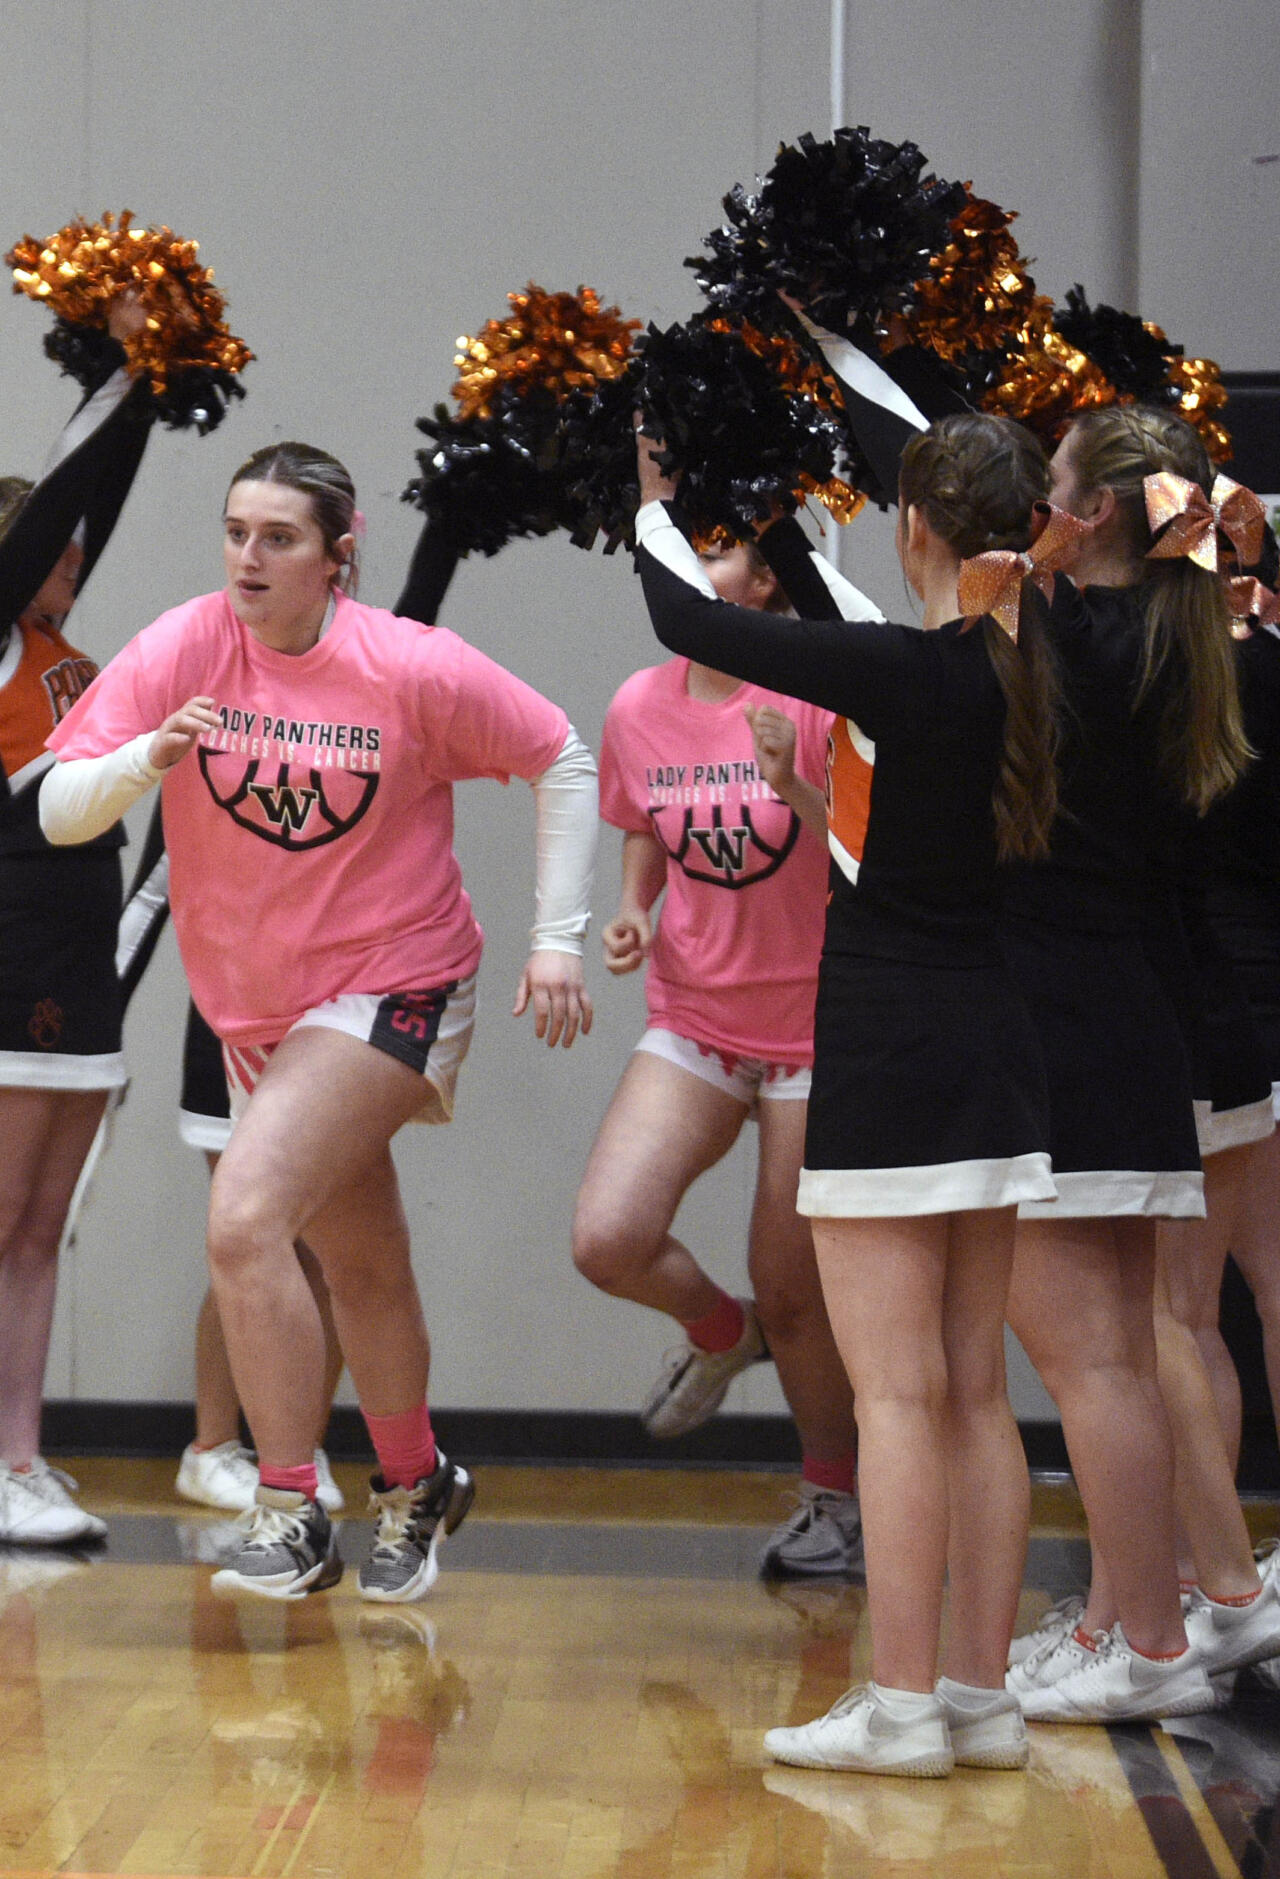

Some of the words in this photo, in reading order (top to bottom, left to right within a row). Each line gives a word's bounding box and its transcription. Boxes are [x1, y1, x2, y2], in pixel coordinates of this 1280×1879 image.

[217, 704, 257, 737] ADY
[261, 713, 382, 752] PANTHERS
[312, 746, 382, 772] CANCER
[646, 764, 688, 789] LADY
[247, 782, 319, 832] W
[688, 825, 751, 872] W
